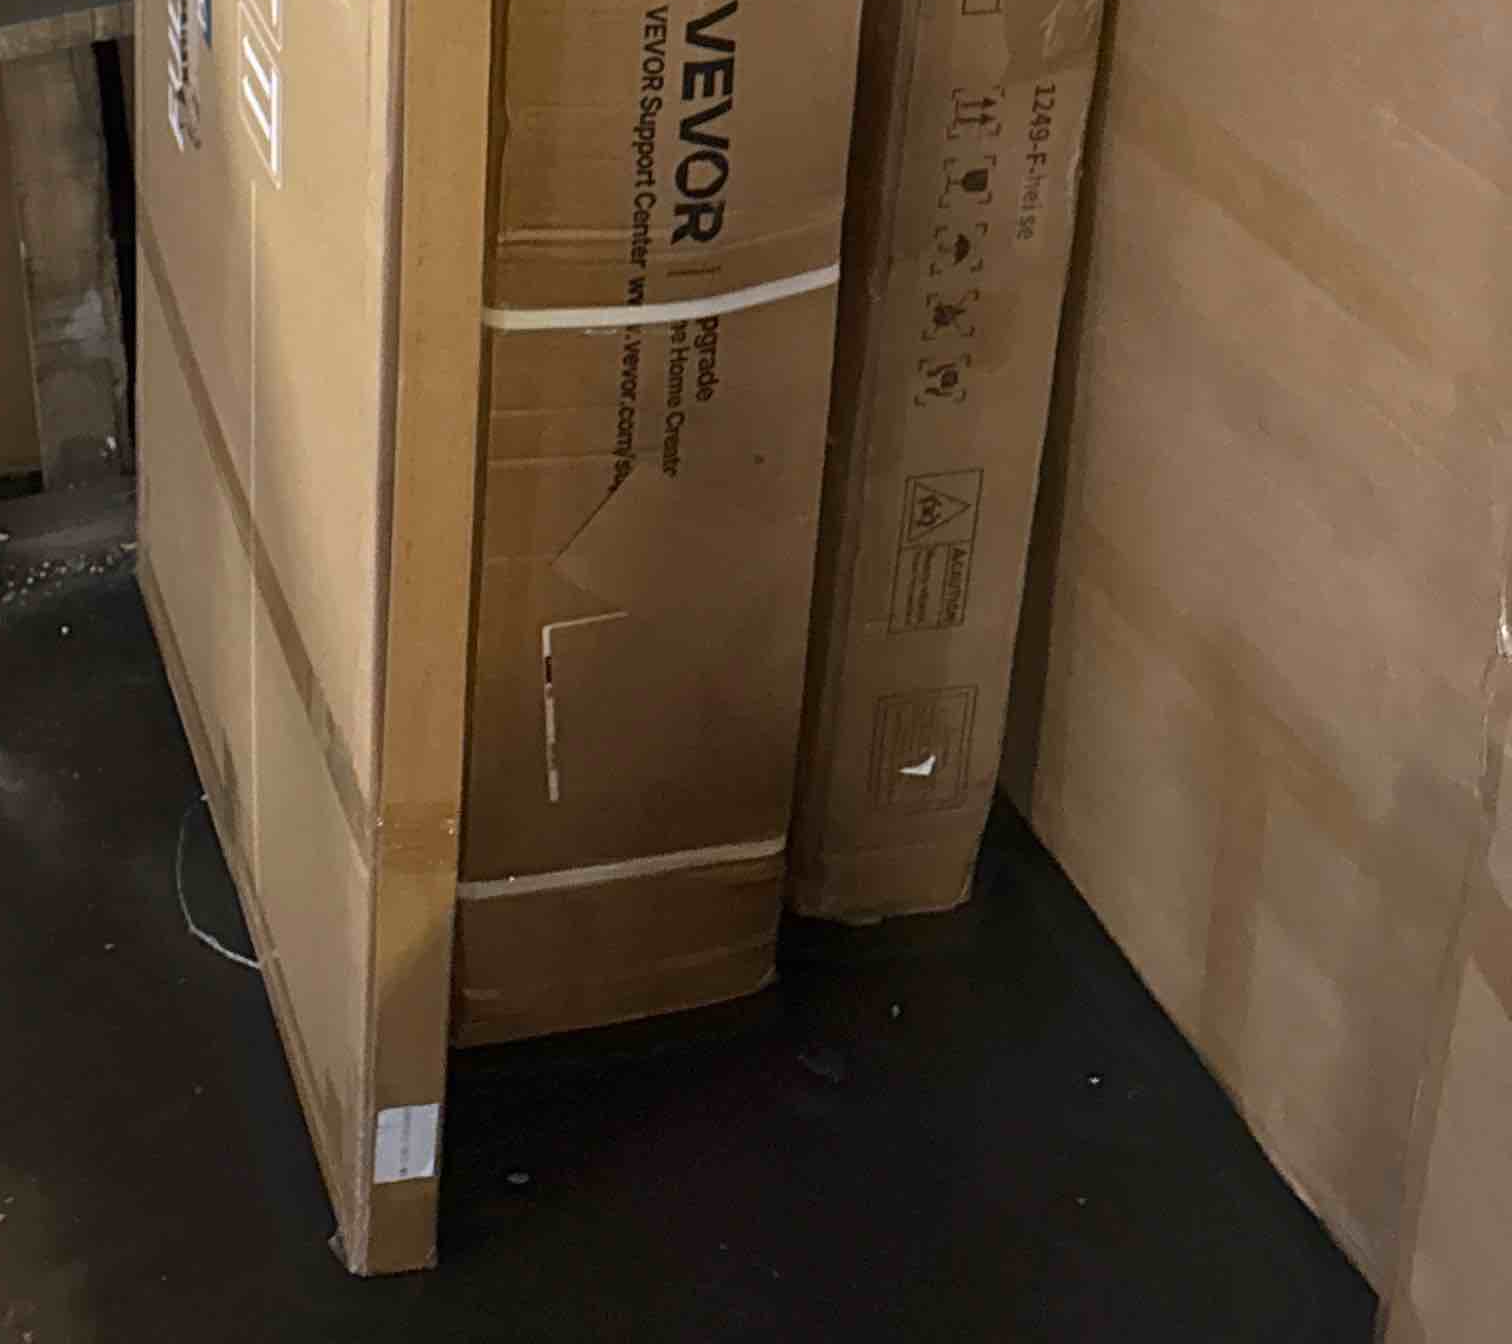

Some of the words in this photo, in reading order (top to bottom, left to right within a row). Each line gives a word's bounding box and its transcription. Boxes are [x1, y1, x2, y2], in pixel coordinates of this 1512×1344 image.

[640, 5, 669, 92] VEVOR
[633, 96, 663, 188] Support
[630, 192, 657, 269] Center
[667, 347, 691, 409] Home
[693, 315, 720, 402] pgrade
